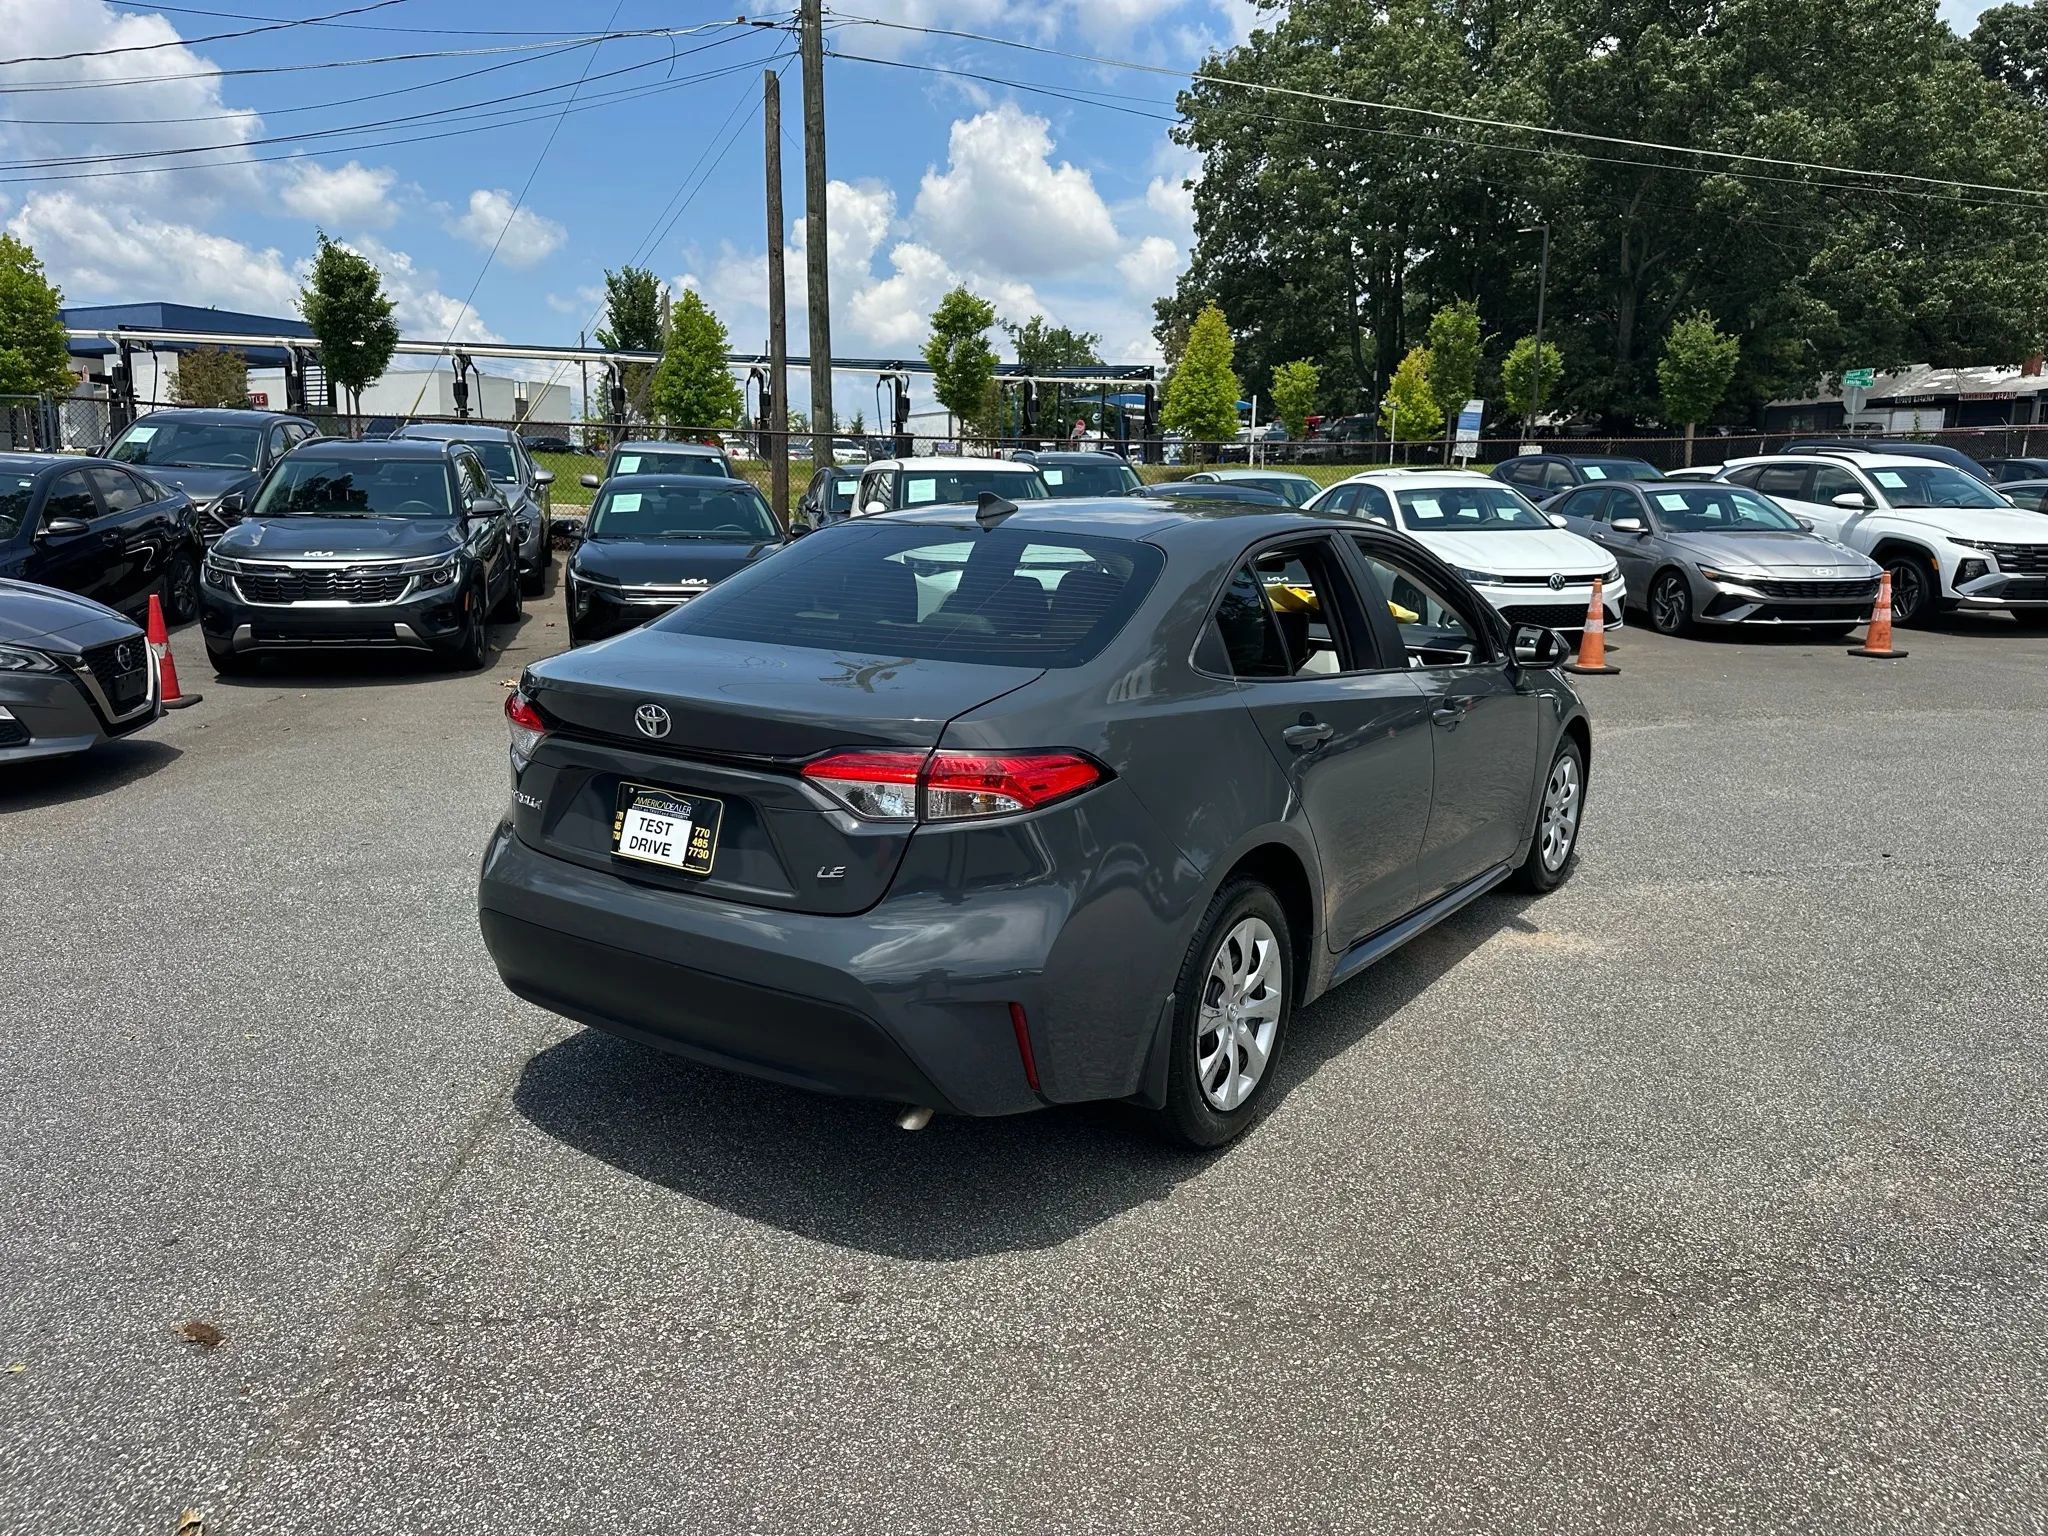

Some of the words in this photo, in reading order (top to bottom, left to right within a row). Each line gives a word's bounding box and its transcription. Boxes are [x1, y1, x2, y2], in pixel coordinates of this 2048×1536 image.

[634, 796, 692, 815] AMERICADEALER
[639, 817, 674, 837] TEST
[694, 826, 711, 838] 770
[629, 835, 673, 858] DRIVE
[691, 837, 709, 849] 485
[687, 847, 710, 860] 7730
[817, 866, 846, 878] LE
